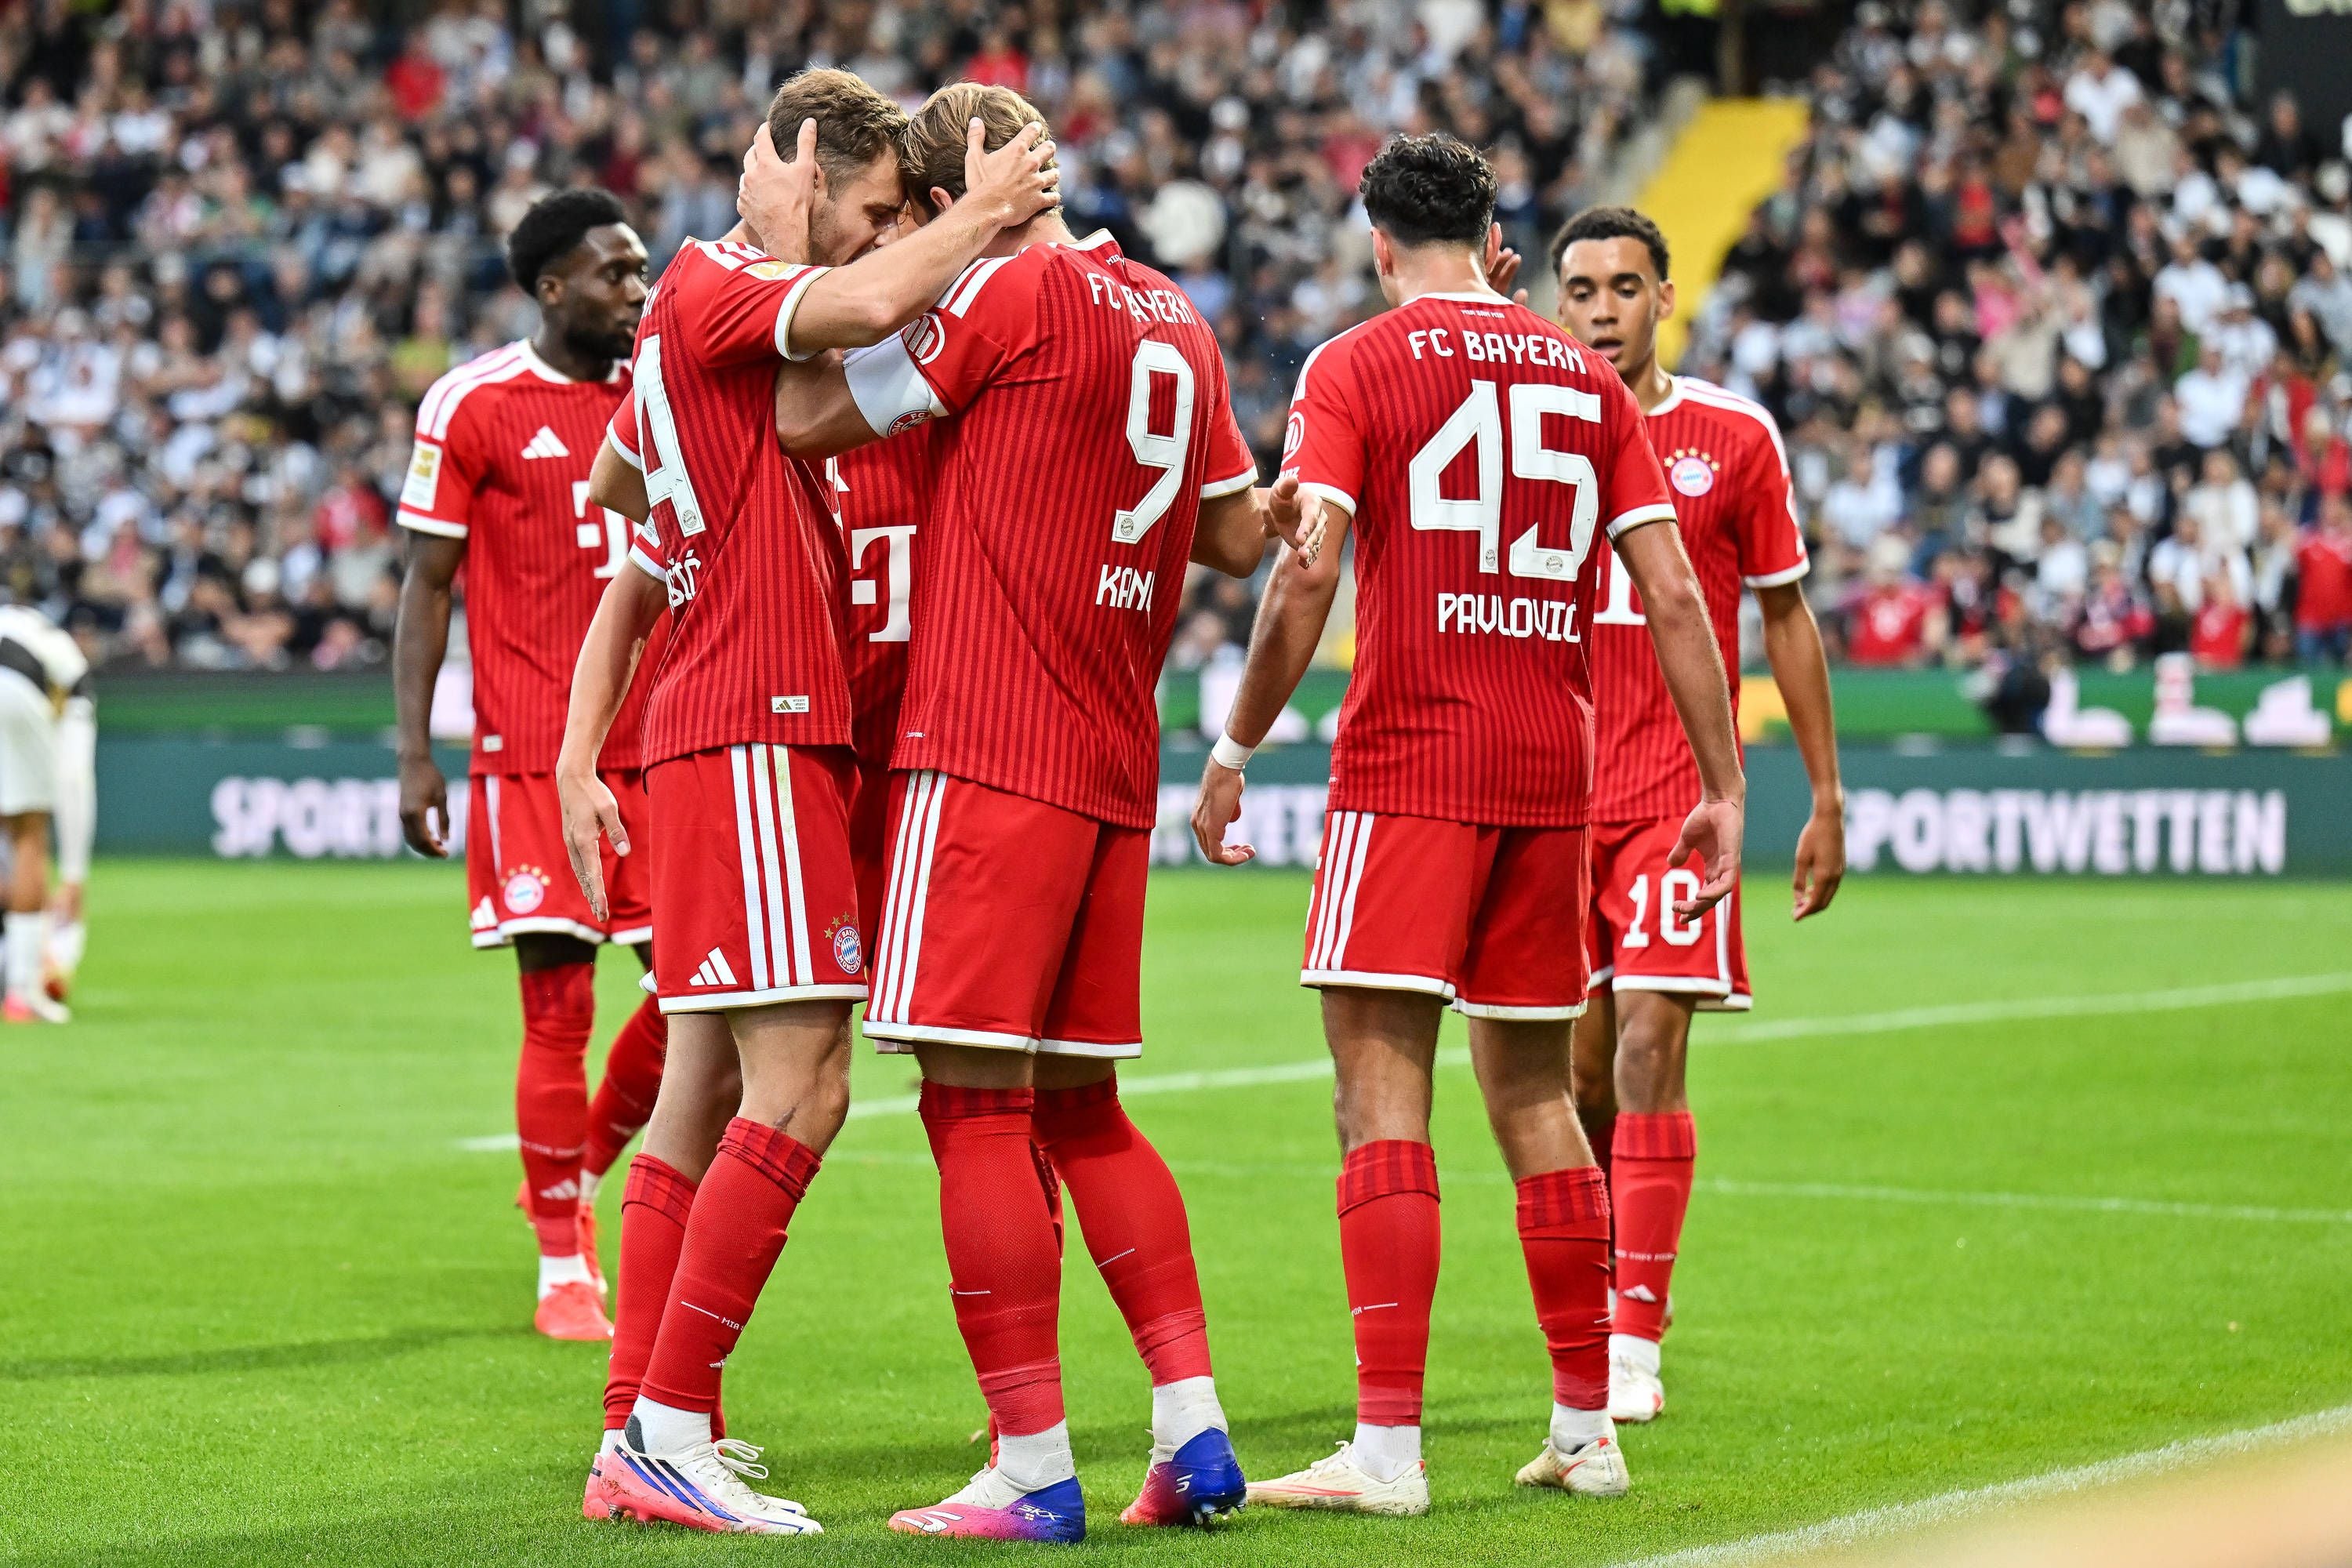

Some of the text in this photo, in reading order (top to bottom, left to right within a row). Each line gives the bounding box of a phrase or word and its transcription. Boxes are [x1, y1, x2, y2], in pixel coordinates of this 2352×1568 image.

[1087, 272, 1121, 310] FC
[1407, 328, 1588, 375] FC BAYERN
[1111, 338, 1195, 544] 9
[1408, 379, 1602, 583] 45
[1622, 869, 1702, 948] 10
[721, 1317, 740, 1330] MIA
